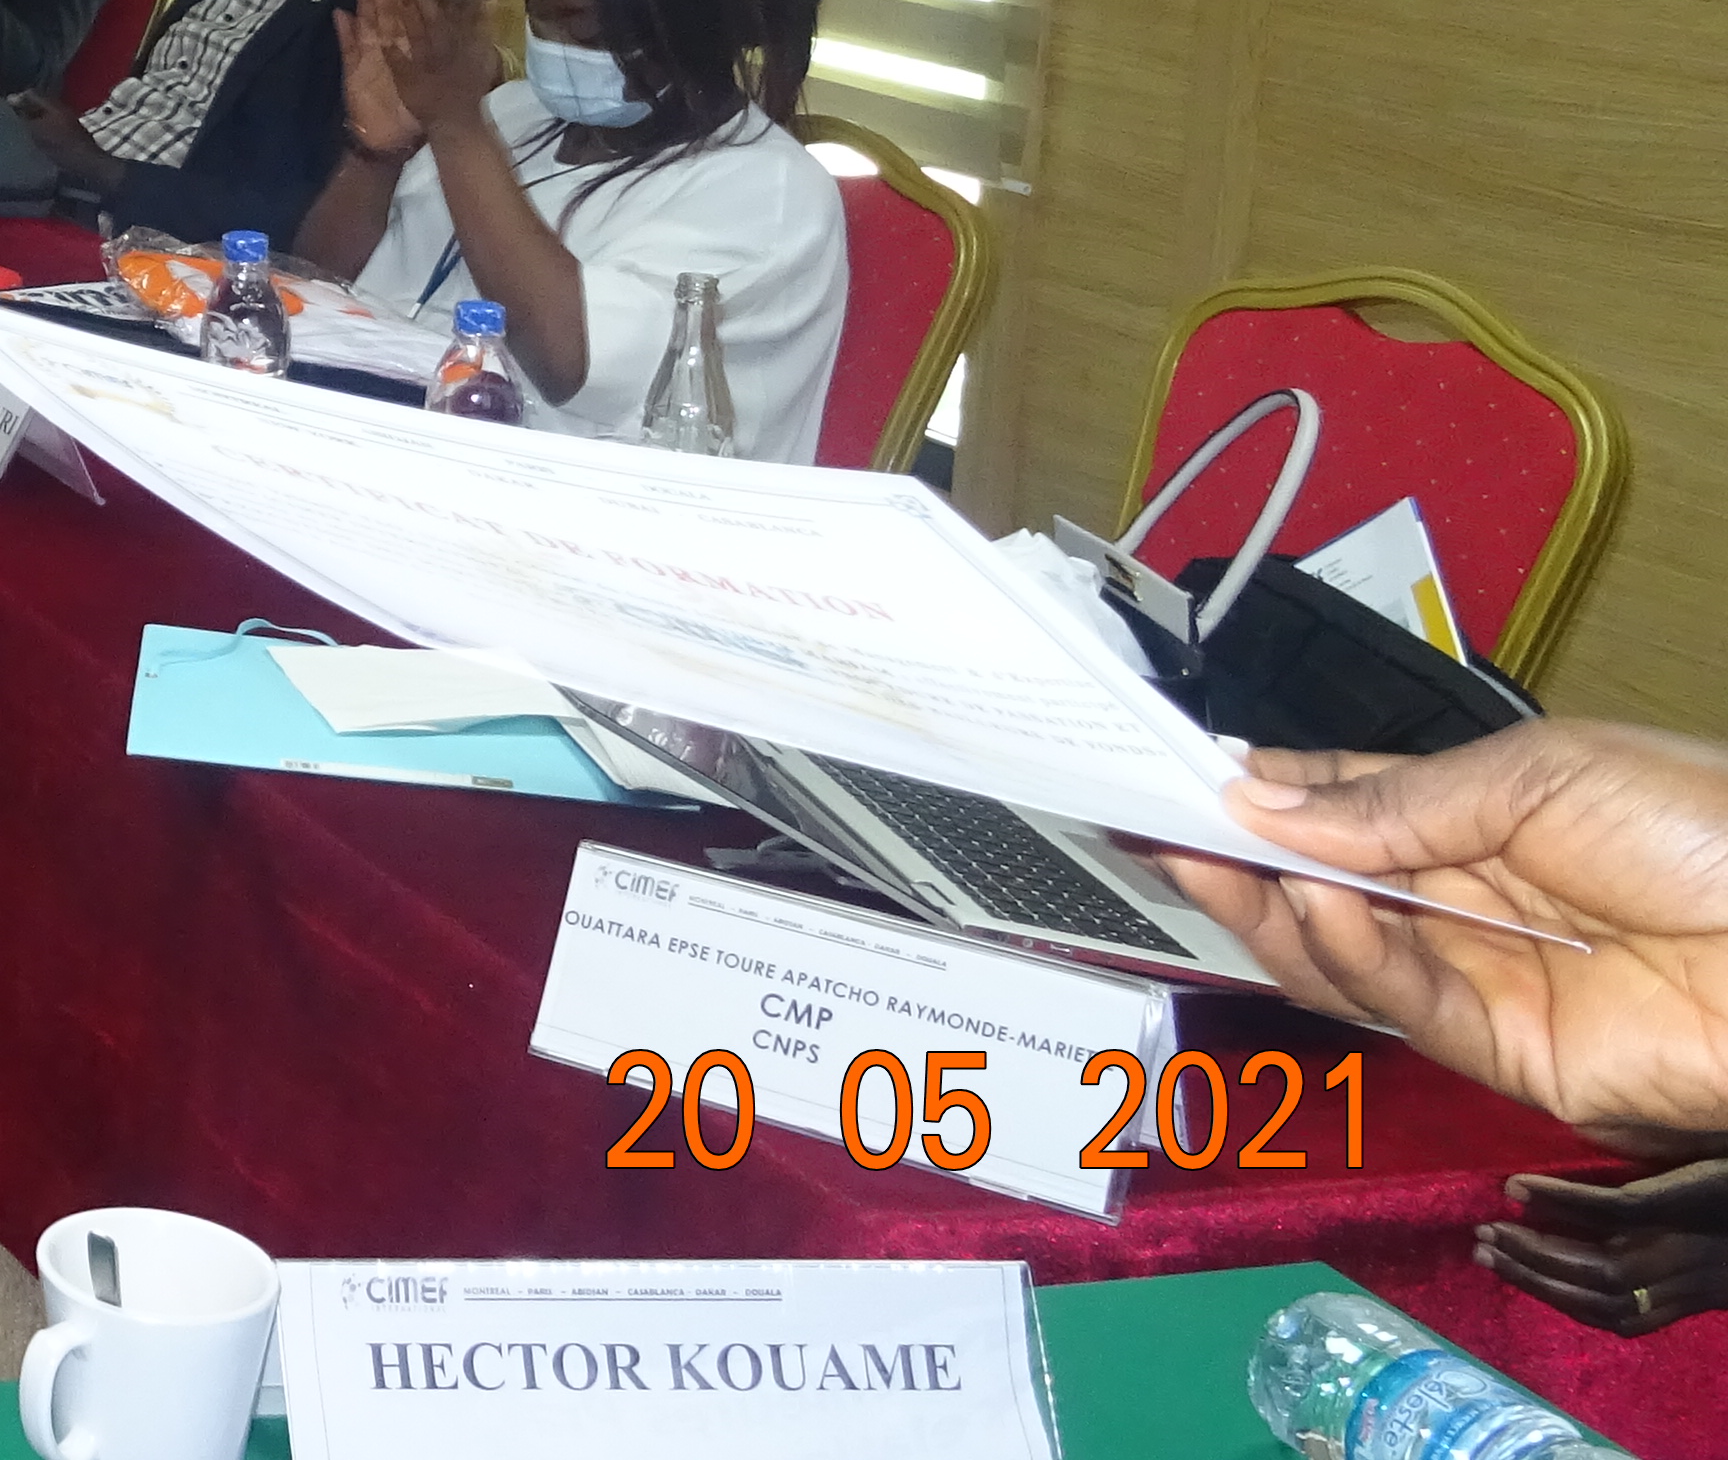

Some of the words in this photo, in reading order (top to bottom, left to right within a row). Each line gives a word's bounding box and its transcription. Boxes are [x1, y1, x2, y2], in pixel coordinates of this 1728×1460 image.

[697, 513, 824, 538] CASABLANCA
[523, 529, 595, 560] DE
[601, 548, 896, 623] FORMATION
[614, 869, 681, 903] CIMEF
[564, 909, 661, 949] OUATTARA
[667, 937, 711, 962] EPSE
[716, 949, 777, 980] TOURE
[781, 967, 880, 1007] APATCHO
[885, 995, 1115, 1072] RAYMONDE-MARIET
[759, 993, 834, 1031] CMP
[752, 1029, 822, 1065] CNPS
[365, 1275, 450, 1305] CIMEF
[462, 1286, 512, 1297] MONTREAL
[526, 1286, 554, 1297] PARIS
[570, 1286, 610, 1297] ABIDJAN
[626, 1287, 686, 1297] CASABLANCA
[694, 1287, 728, 1297] DAKAR
[744, 1287, 783, 1297] DOUALA
[365, 1341, 651, 1392] HECTOR
[663, 1342, 963, 1392] KOUAME
